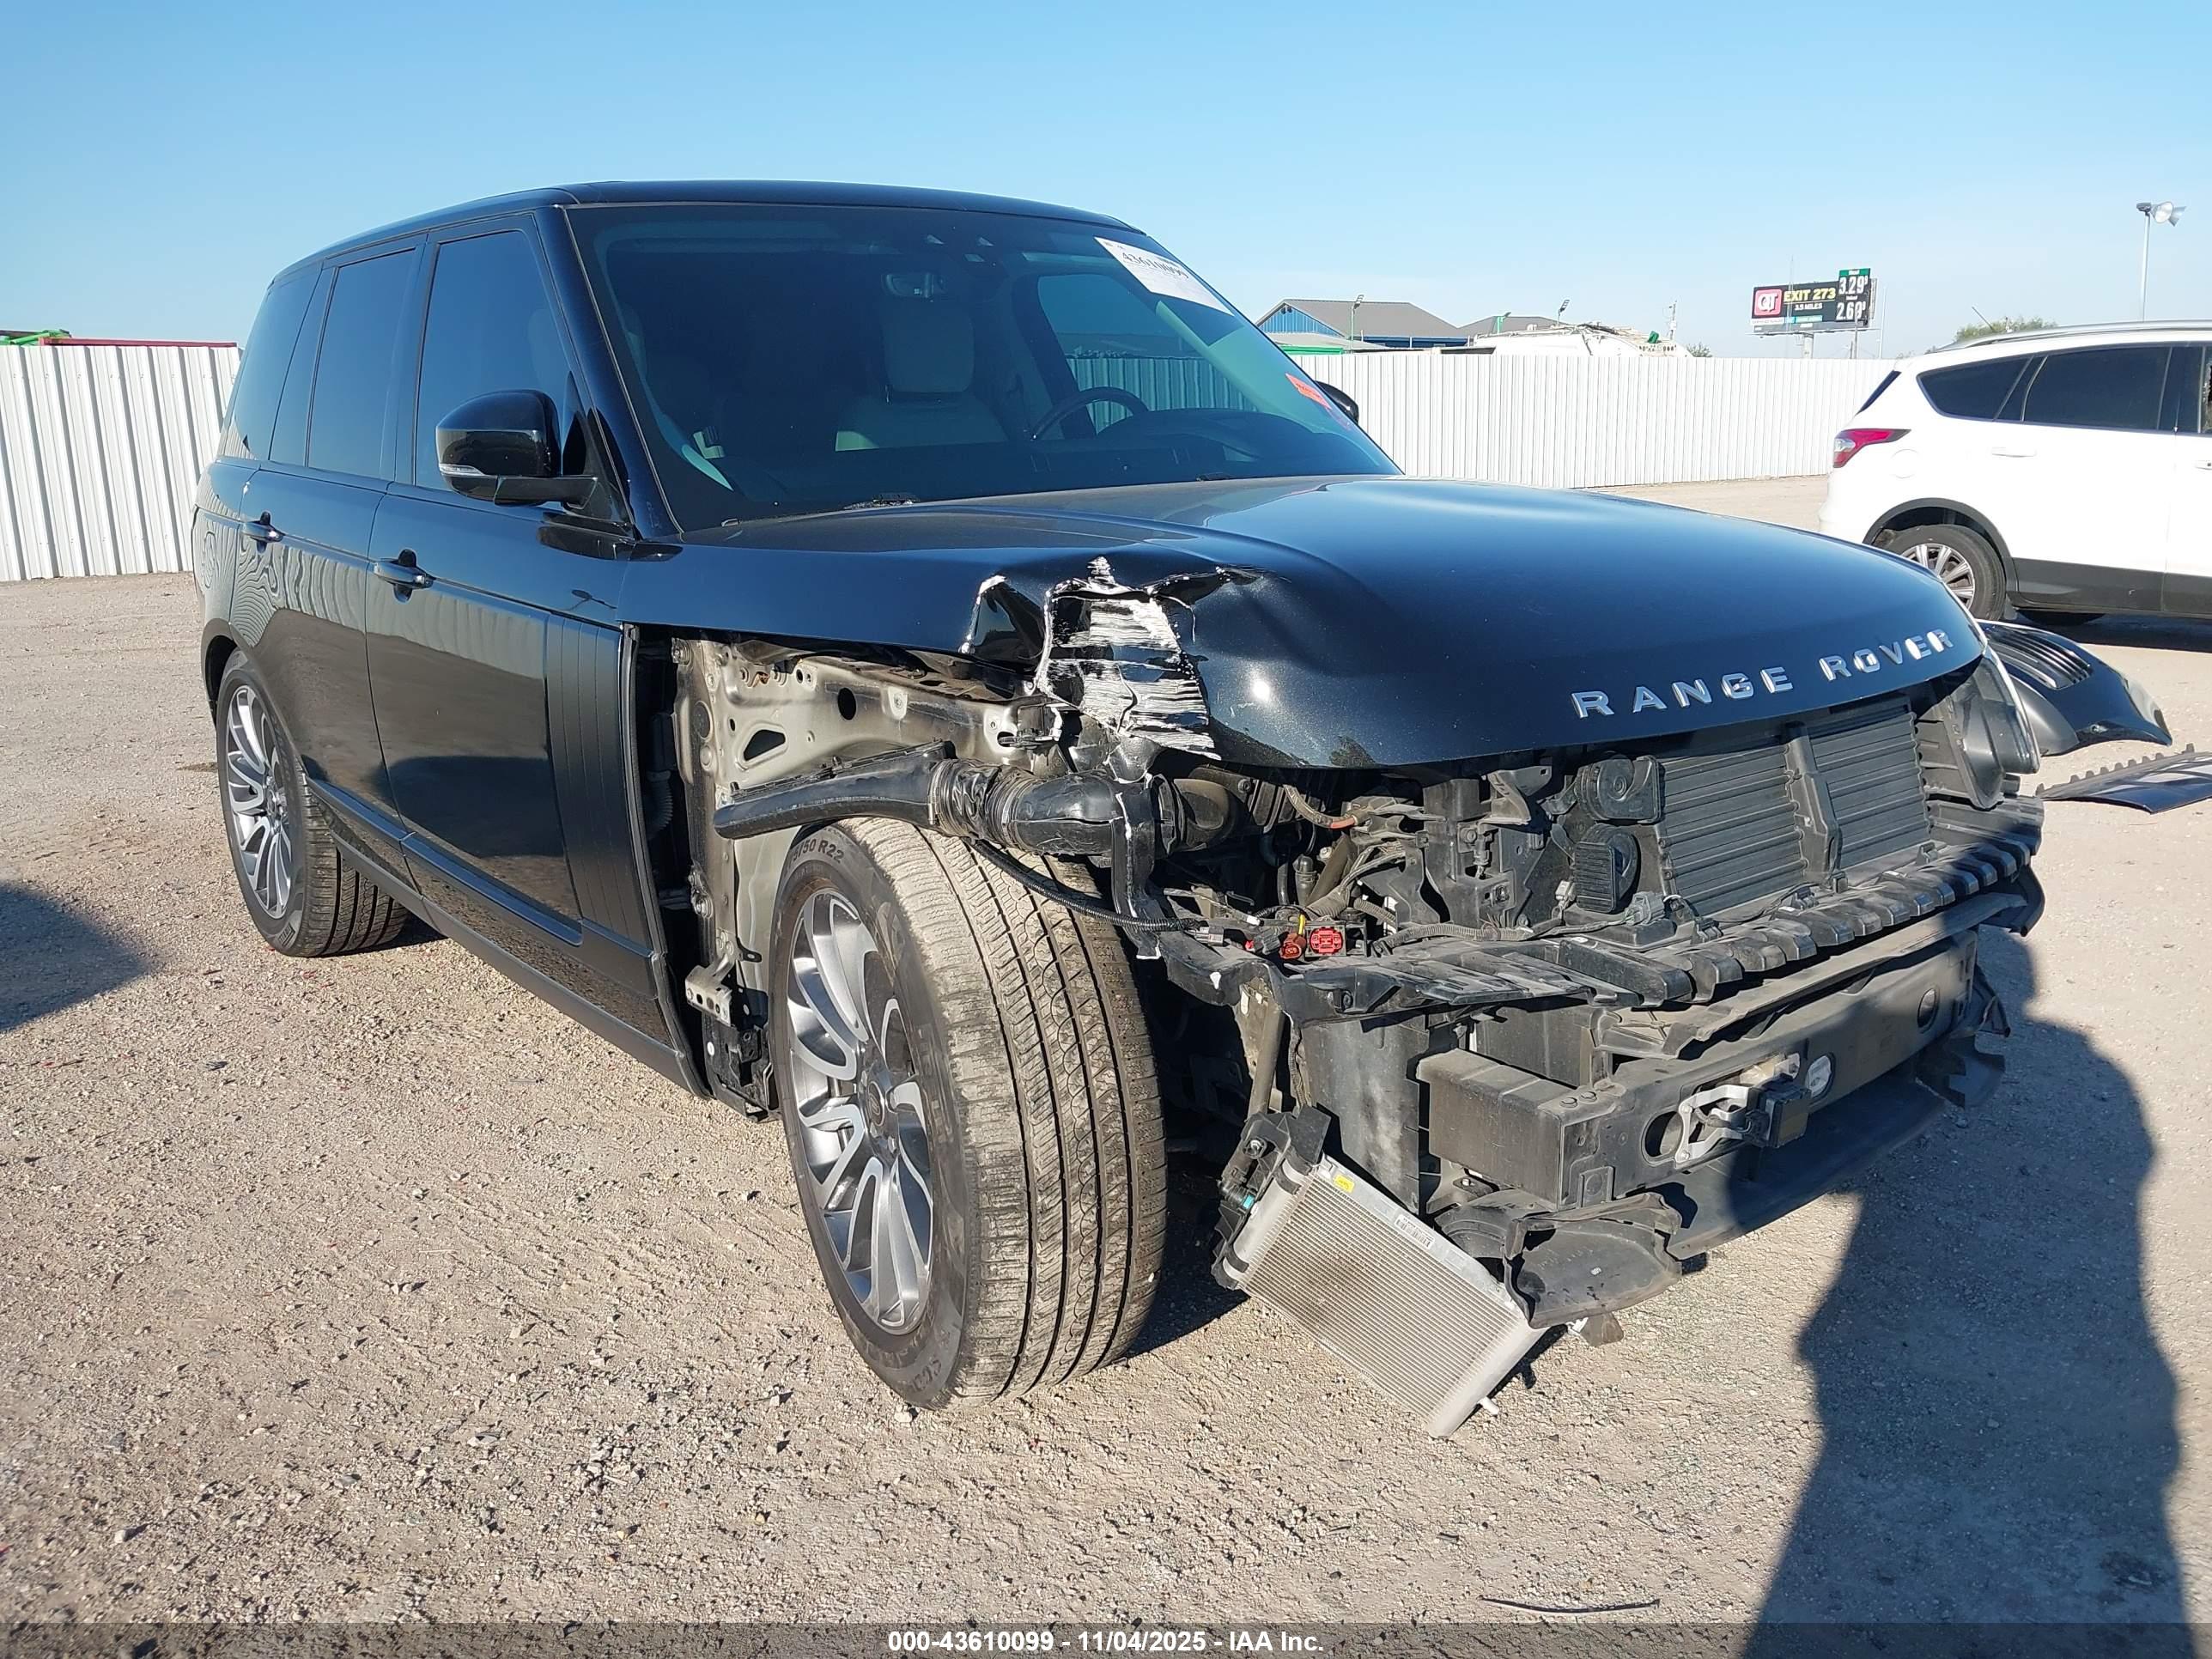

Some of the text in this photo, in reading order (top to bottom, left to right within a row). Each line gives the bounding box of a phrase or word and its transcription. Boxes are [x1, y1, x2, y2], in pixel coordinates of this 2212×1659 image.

[1758, 293, 1778, 313] QT
[1784, 287, 1836, 302] EXIT 273
[1571, 628, 1955, 719] RANGE ROVER
[818, 840, 845, 864] R22
